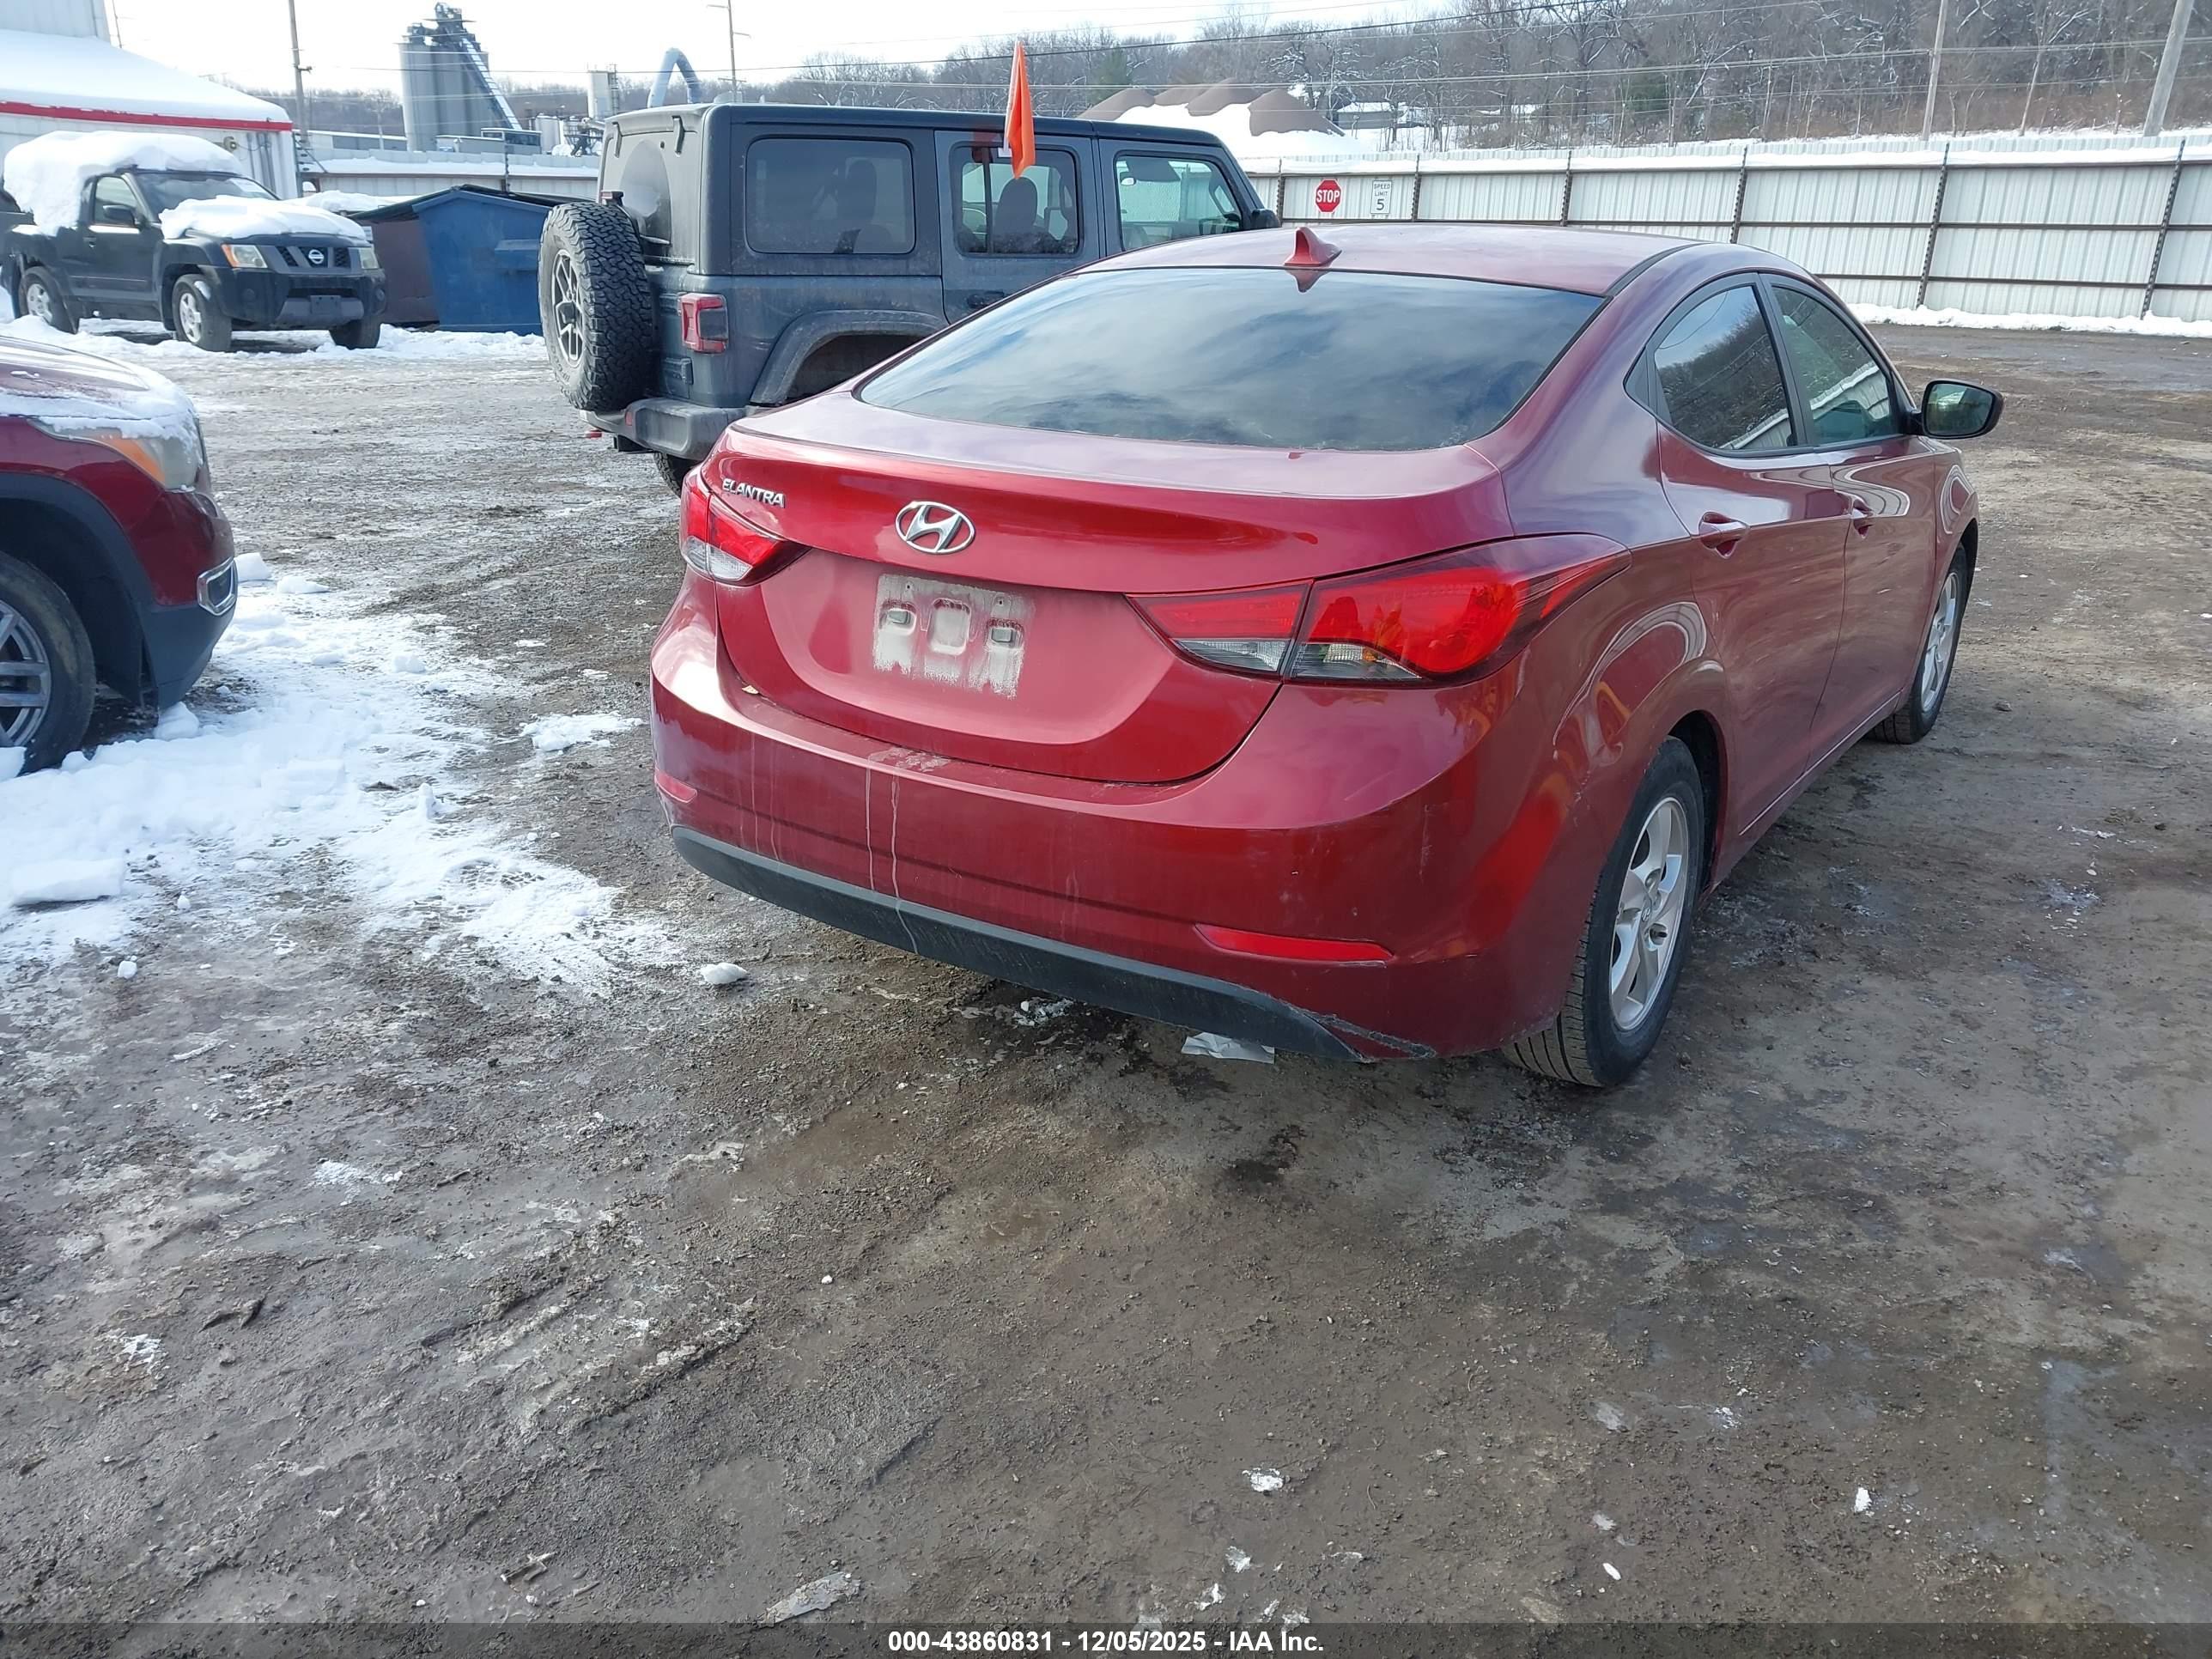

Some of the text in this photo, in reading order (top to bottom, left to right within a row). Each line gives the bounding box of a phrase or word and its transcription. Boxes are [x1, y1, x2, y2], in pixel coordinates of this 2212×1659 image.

[1316, 190, 1340, 203] STOP
[1376, 198, 1385, 211] 5
[722, 477, 785, 508] ELANTRA
